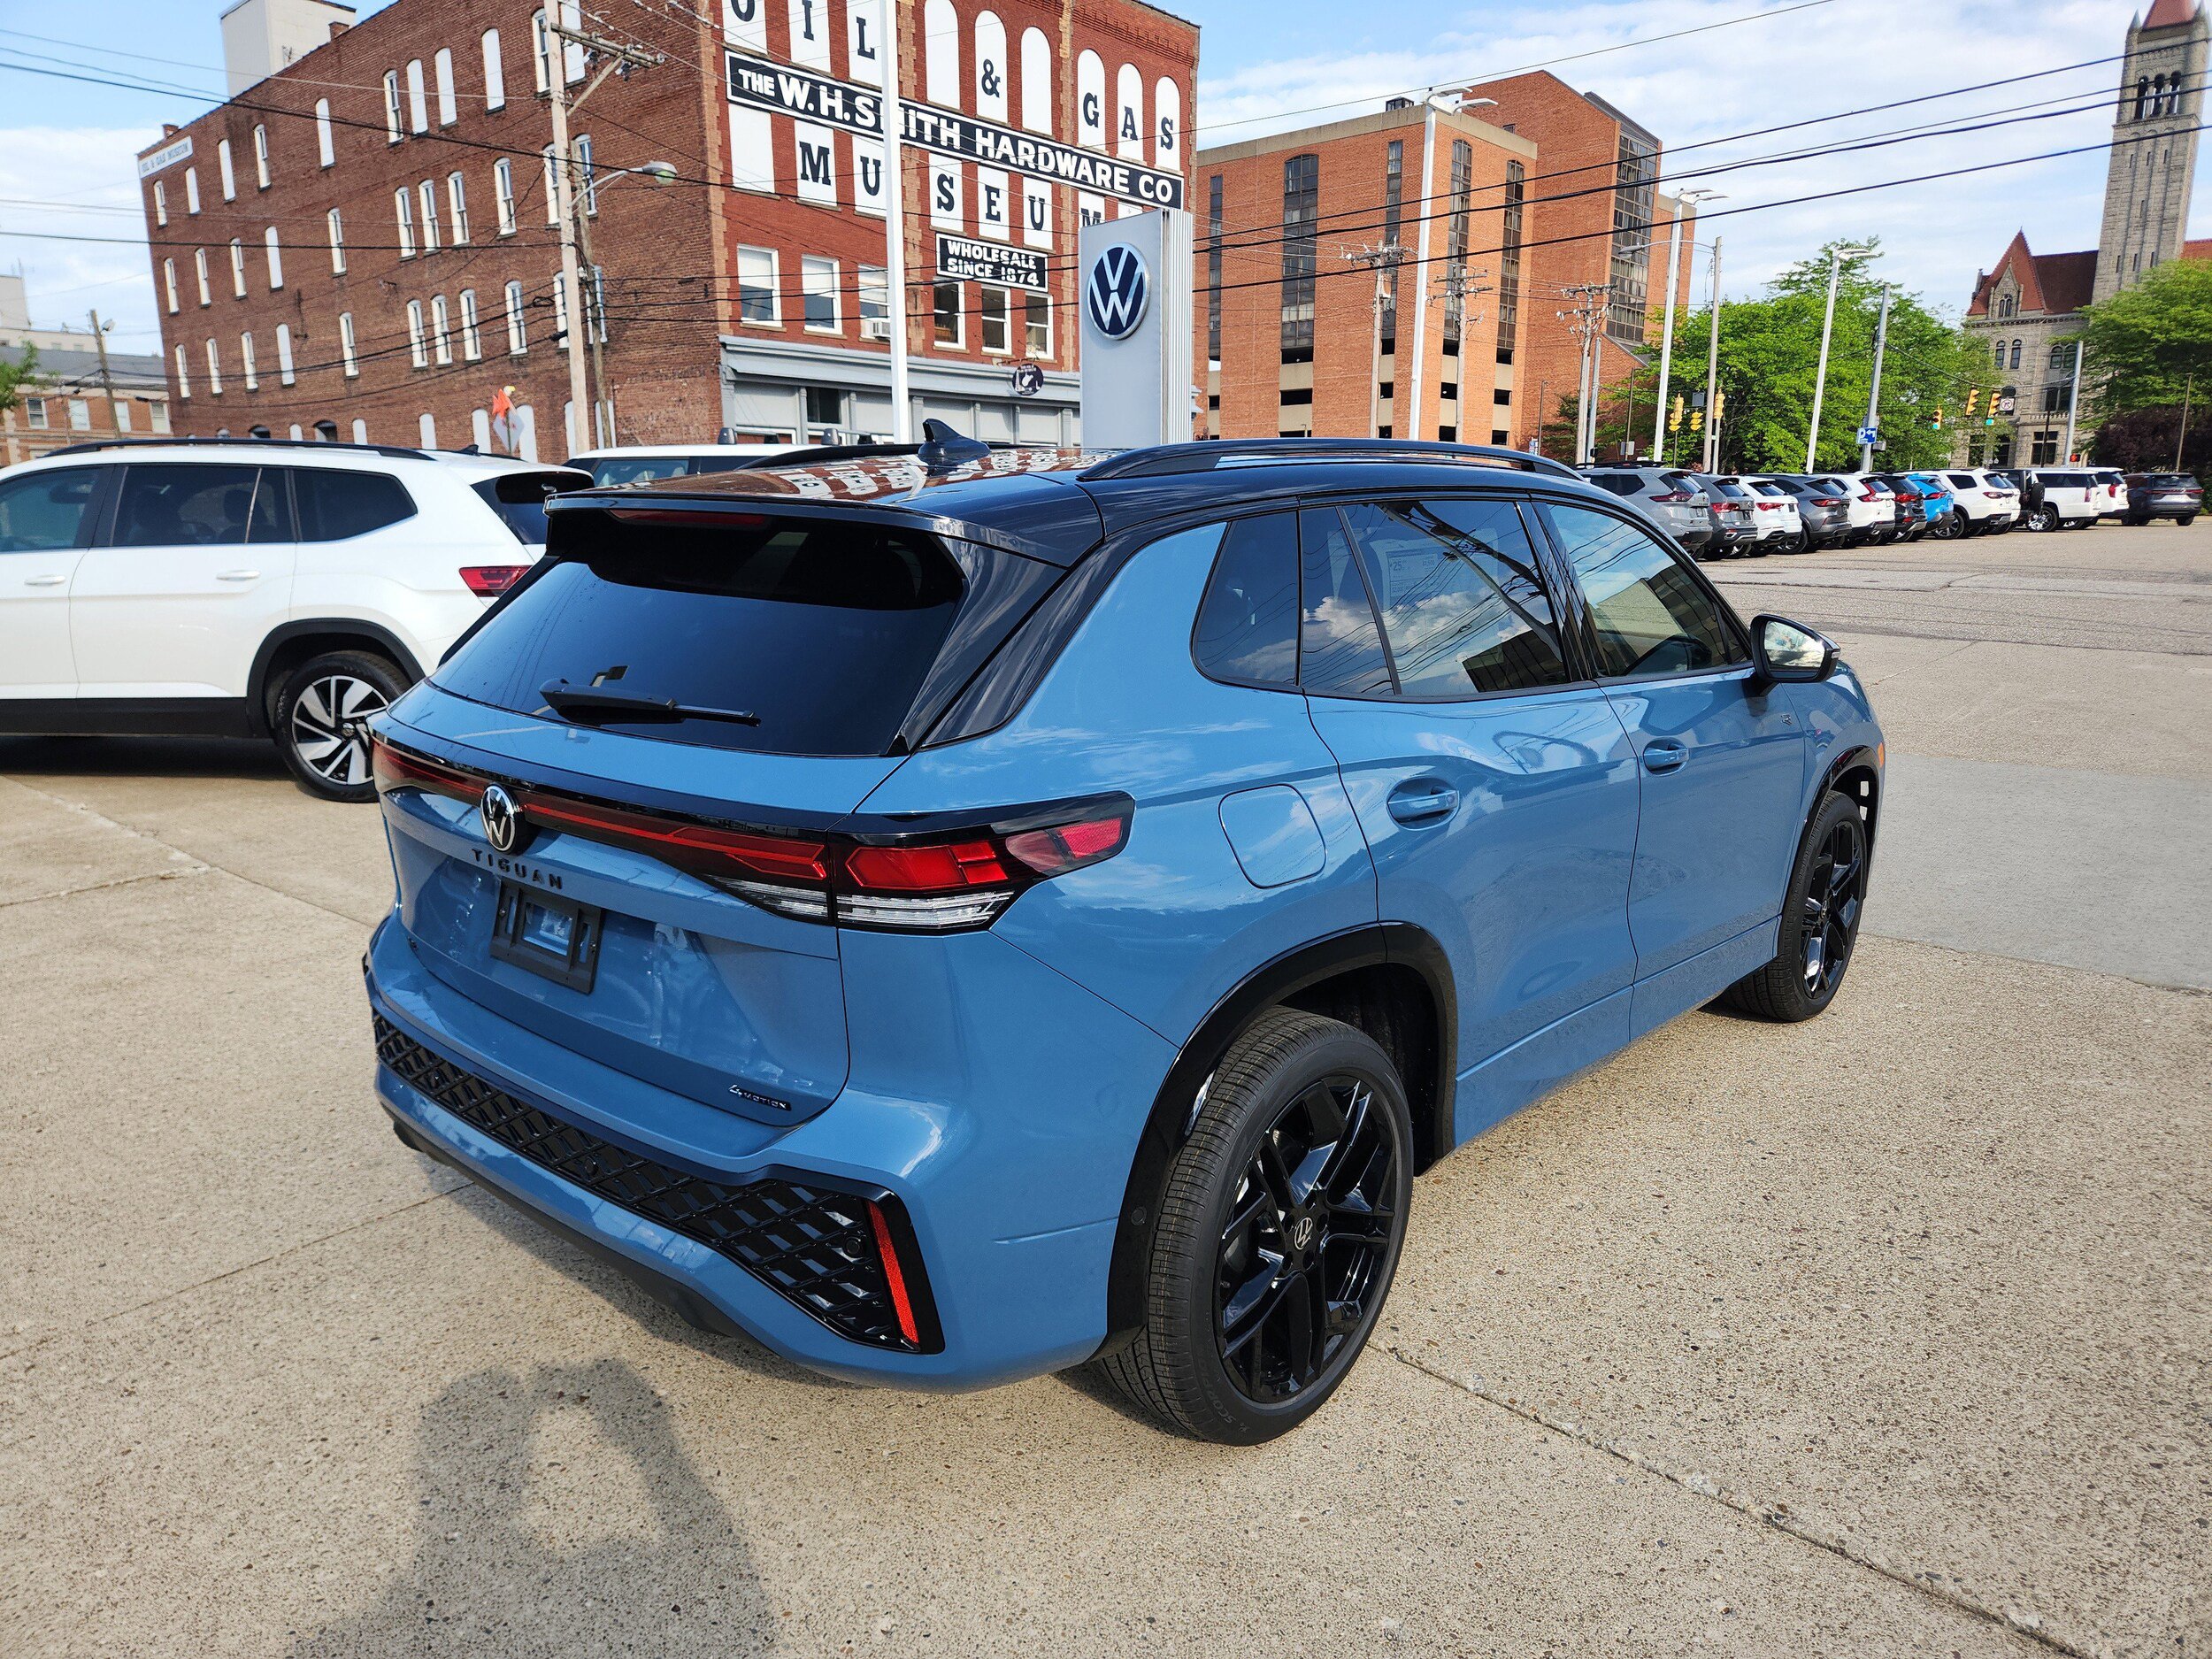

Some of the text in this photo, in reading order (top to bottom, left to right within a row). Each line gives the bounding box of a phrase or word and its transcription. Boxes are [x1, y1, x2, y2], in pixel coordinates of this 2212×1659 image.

[980, 58, 1001, 96] &
[1082, 92, 1174, 151] GAS
[738, 68, 775, 97] THE
[855, 95, 961, 150] SITH
[975, 128, 1130, 192] HARDWARE
[1138, 174, 1173, 204] CO
[947, 240, 1037, 271] WHOLESALE
[947, 257, 1040, 287] SINCE 1874
[472, 847, 562, 890] TIGUAN
